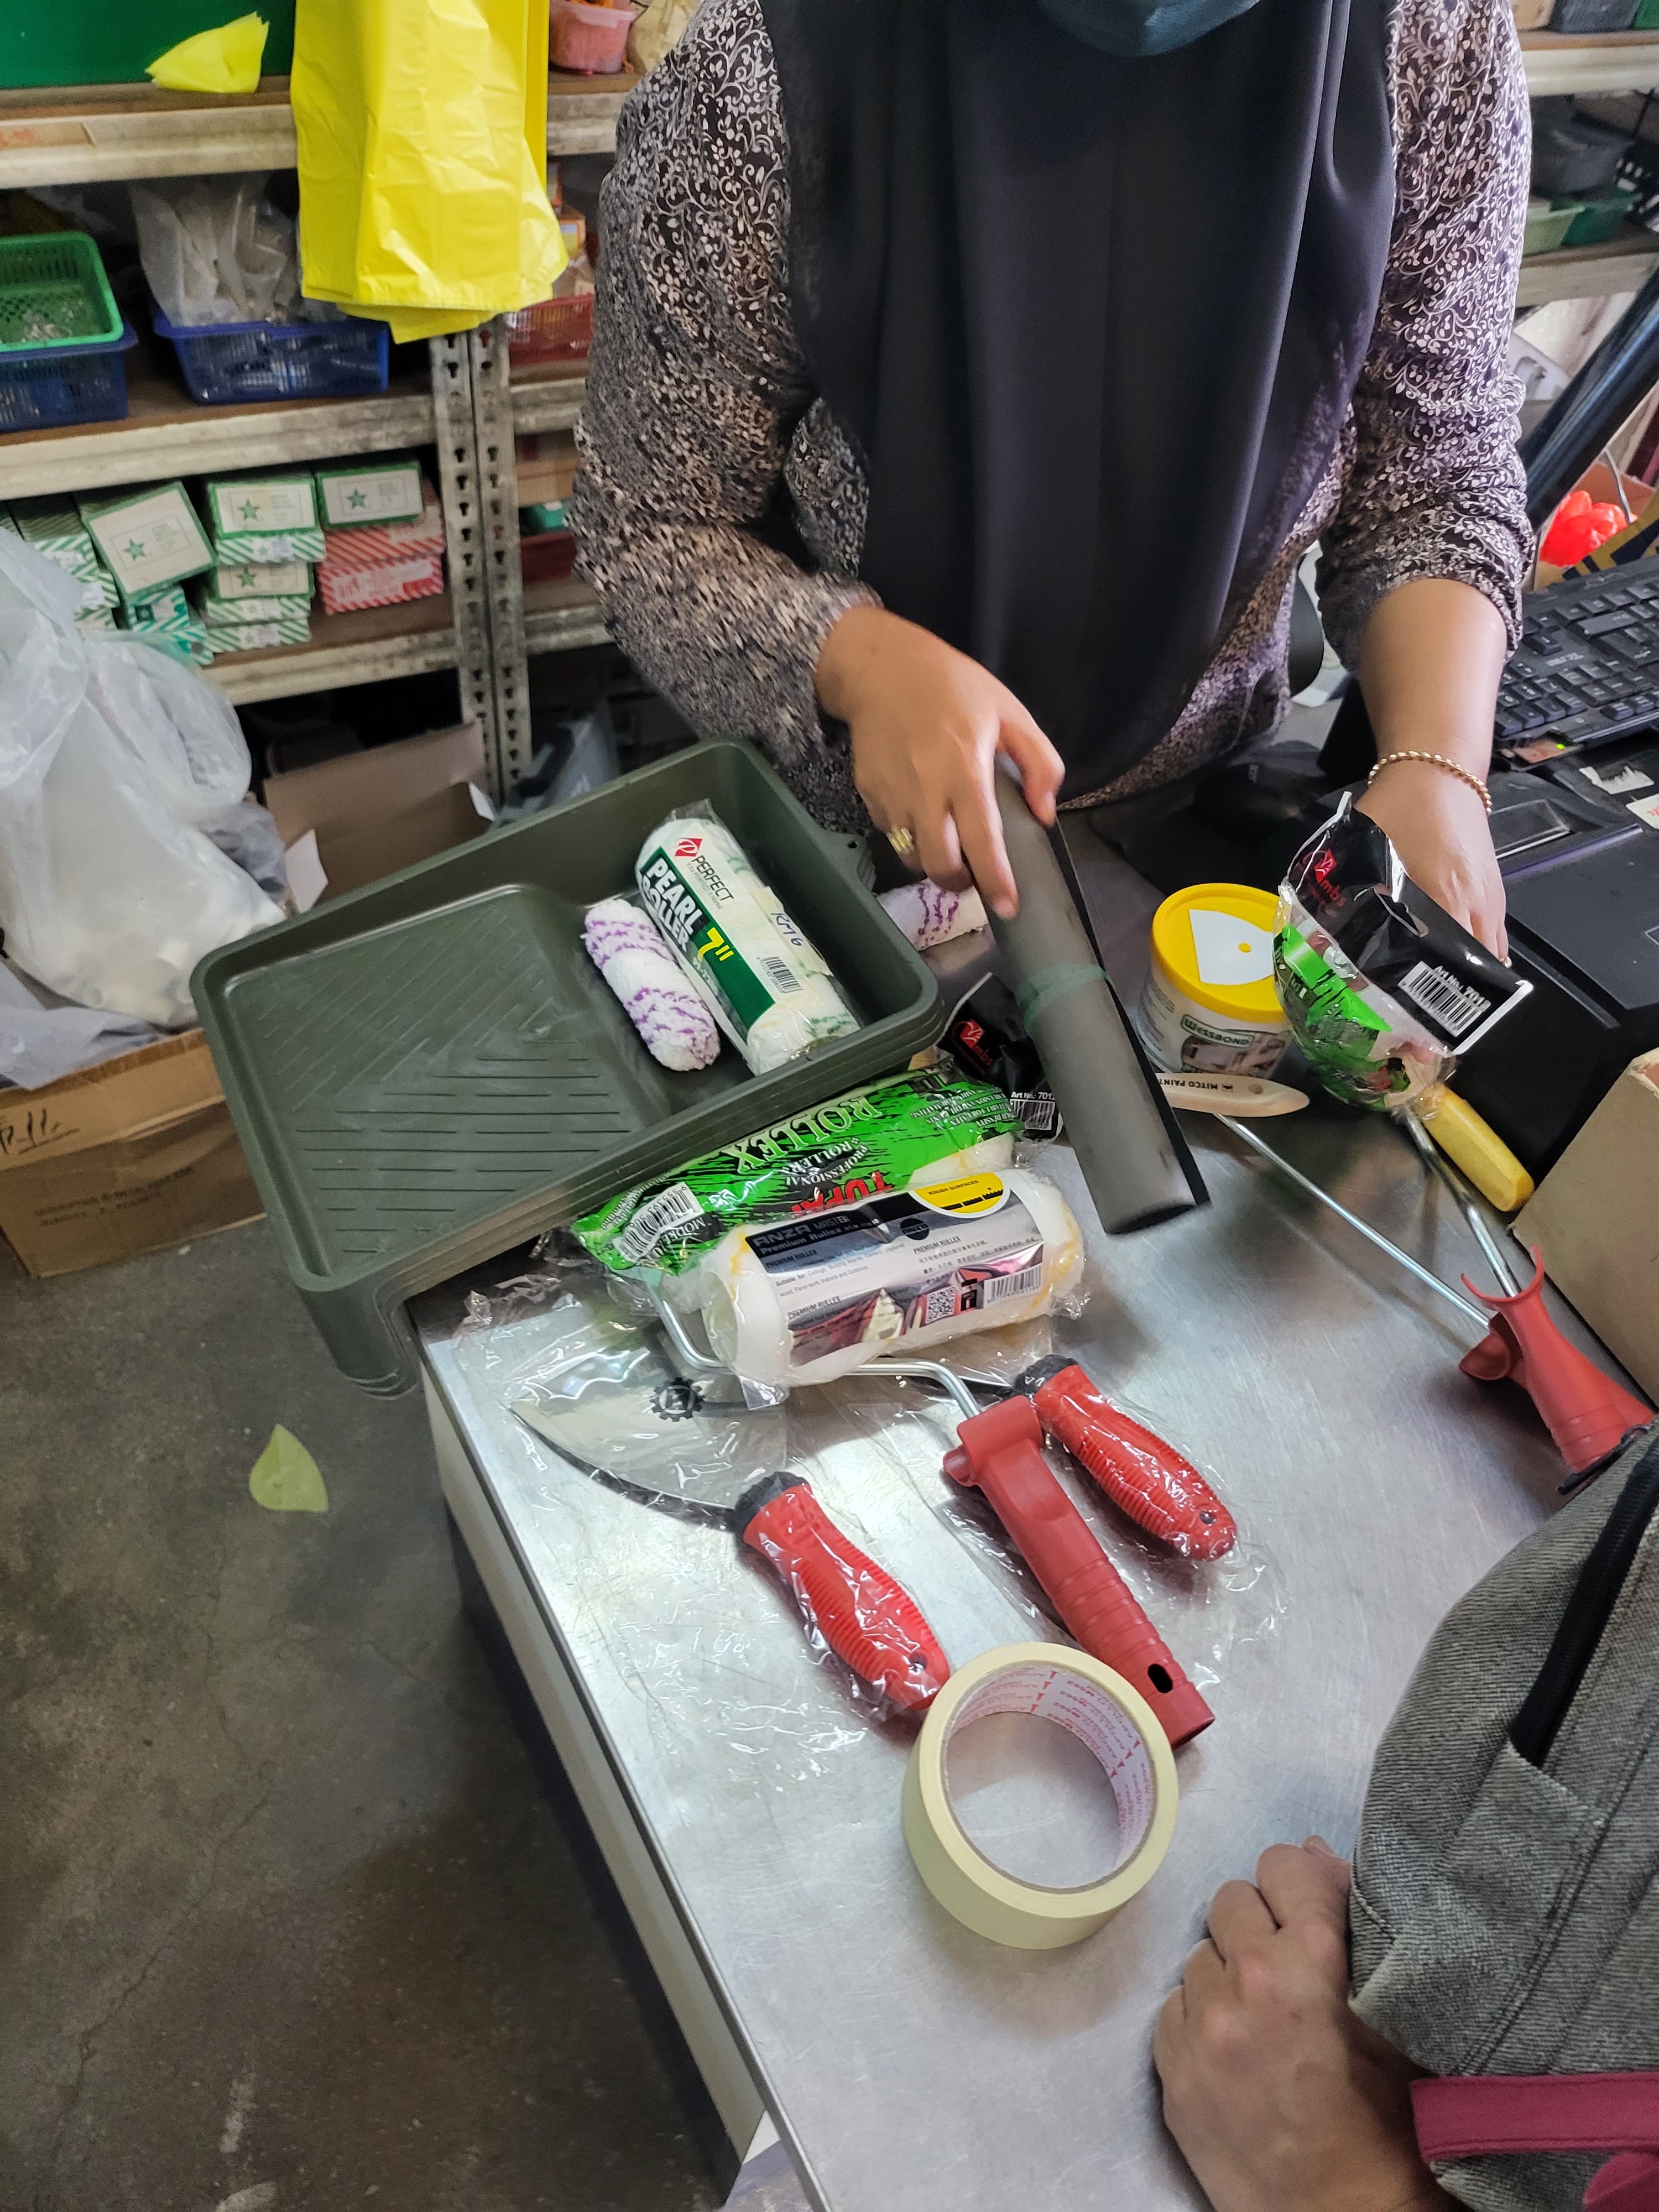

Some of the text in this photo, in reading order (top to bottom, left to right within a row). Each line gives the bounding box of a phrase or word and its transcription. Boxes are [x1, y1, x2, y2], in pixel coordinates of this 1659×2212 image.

[691, 855, 734, 901] PERFECT
[693, 870, 711, 892] PERFECT
[647, 858, 702, 935] PEARL
[642, 875, 689, 952] ROLLER
[1188, 1081, 1218, 1090] MITCO
[722, 1097, 883, 1175] ROLLEX
[977, 1116, 1001, 1128] DENSITY
[786, 1144, 868, 1186] PROFESSIONAL
[949, 1180, 980, 1191] SURFACES
[752, 1224, 812, 1247] ANZA
[813, 1215, 852, 1230] MASTER
[760, 1238, 808, 1255] Premium
[810, 1226, 843, 1241] Rullex
[912, 1242, 940, 1255] PREMIUM
[938, 1235, 962, 1248] RULLEX
[765, 1255, 795, 1269] PREMIUM
[795, 1249, 818, 1262] RULLEX
